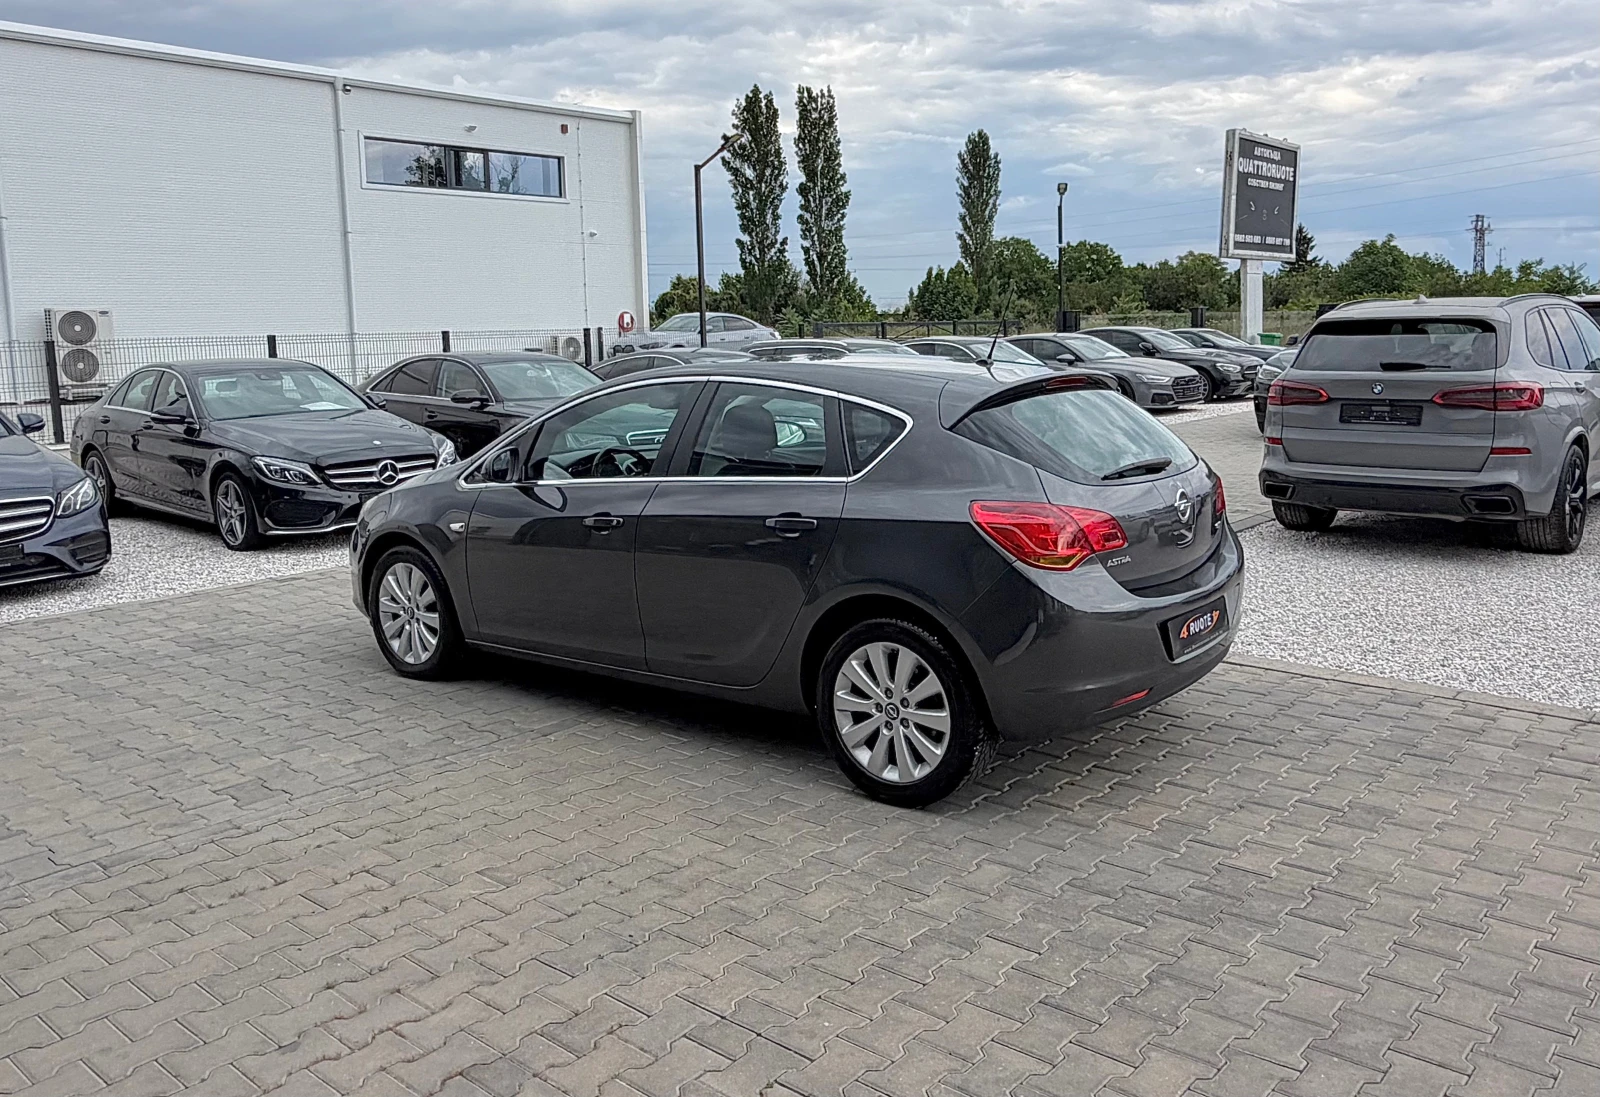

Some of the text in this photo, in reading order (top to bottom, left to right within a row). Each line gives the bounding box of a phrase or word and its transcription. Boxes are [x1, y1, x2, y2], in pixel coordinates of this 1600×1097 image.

[1238, 157, 1295, 181] QUATTRORUOTE
[1107, 555, 1131, 567] ASTRA
[1189, 613, 1212, 636] RUOTE
